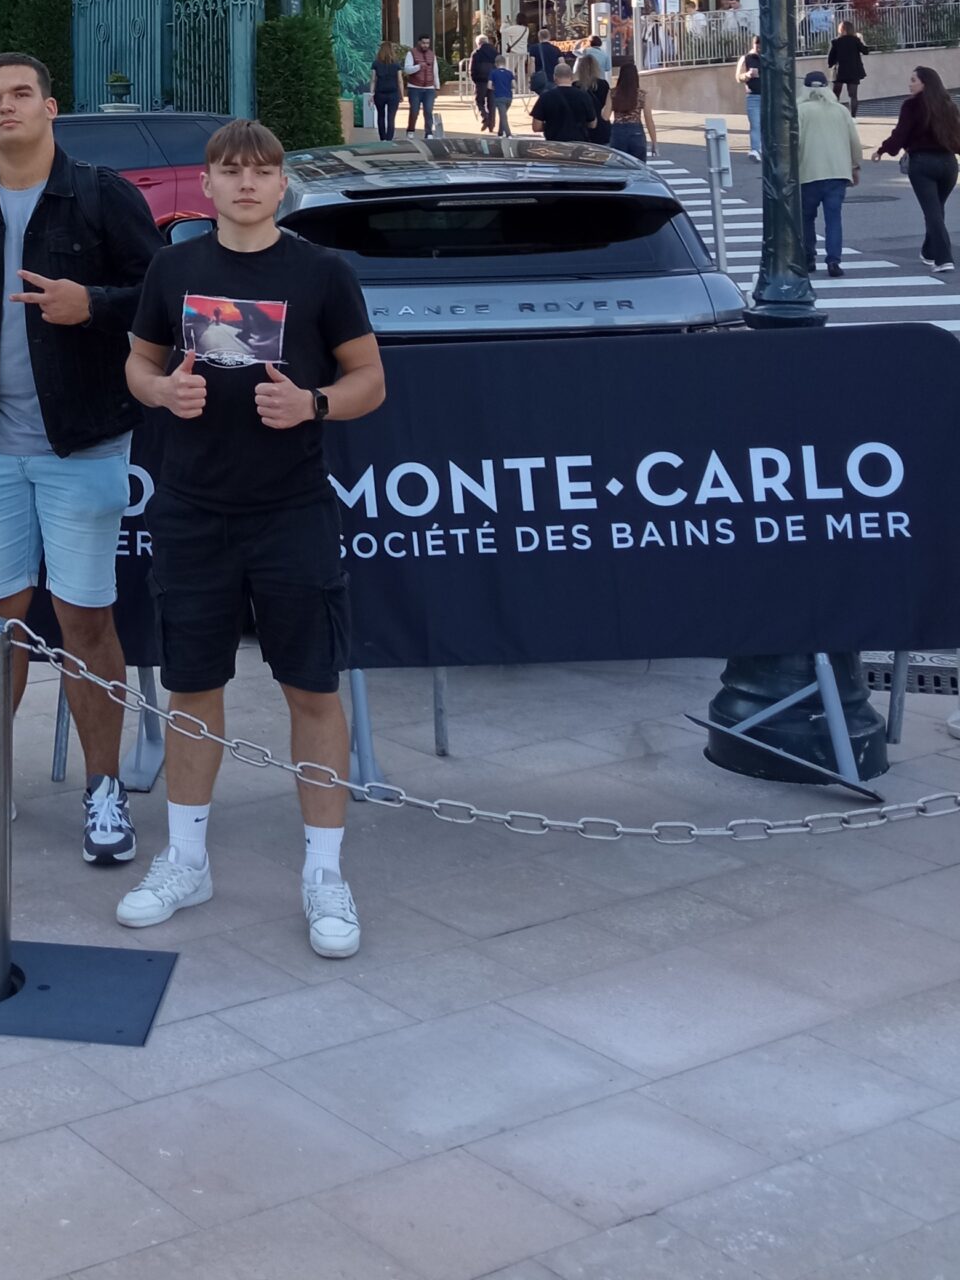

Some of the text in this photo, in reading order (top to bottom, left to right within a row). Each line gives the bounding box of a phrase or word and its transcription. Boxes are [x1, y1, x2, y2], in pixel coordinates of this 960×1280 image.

[372, 299, 635, 316] RANGE ROVER
[116, 530, 153, 557] ER
[515, 523, 592, 552] DES
[611, 518, 736, 549] BAINS
[755, 515, 807, 544] DE
[825, 511, 912, 540] MER
